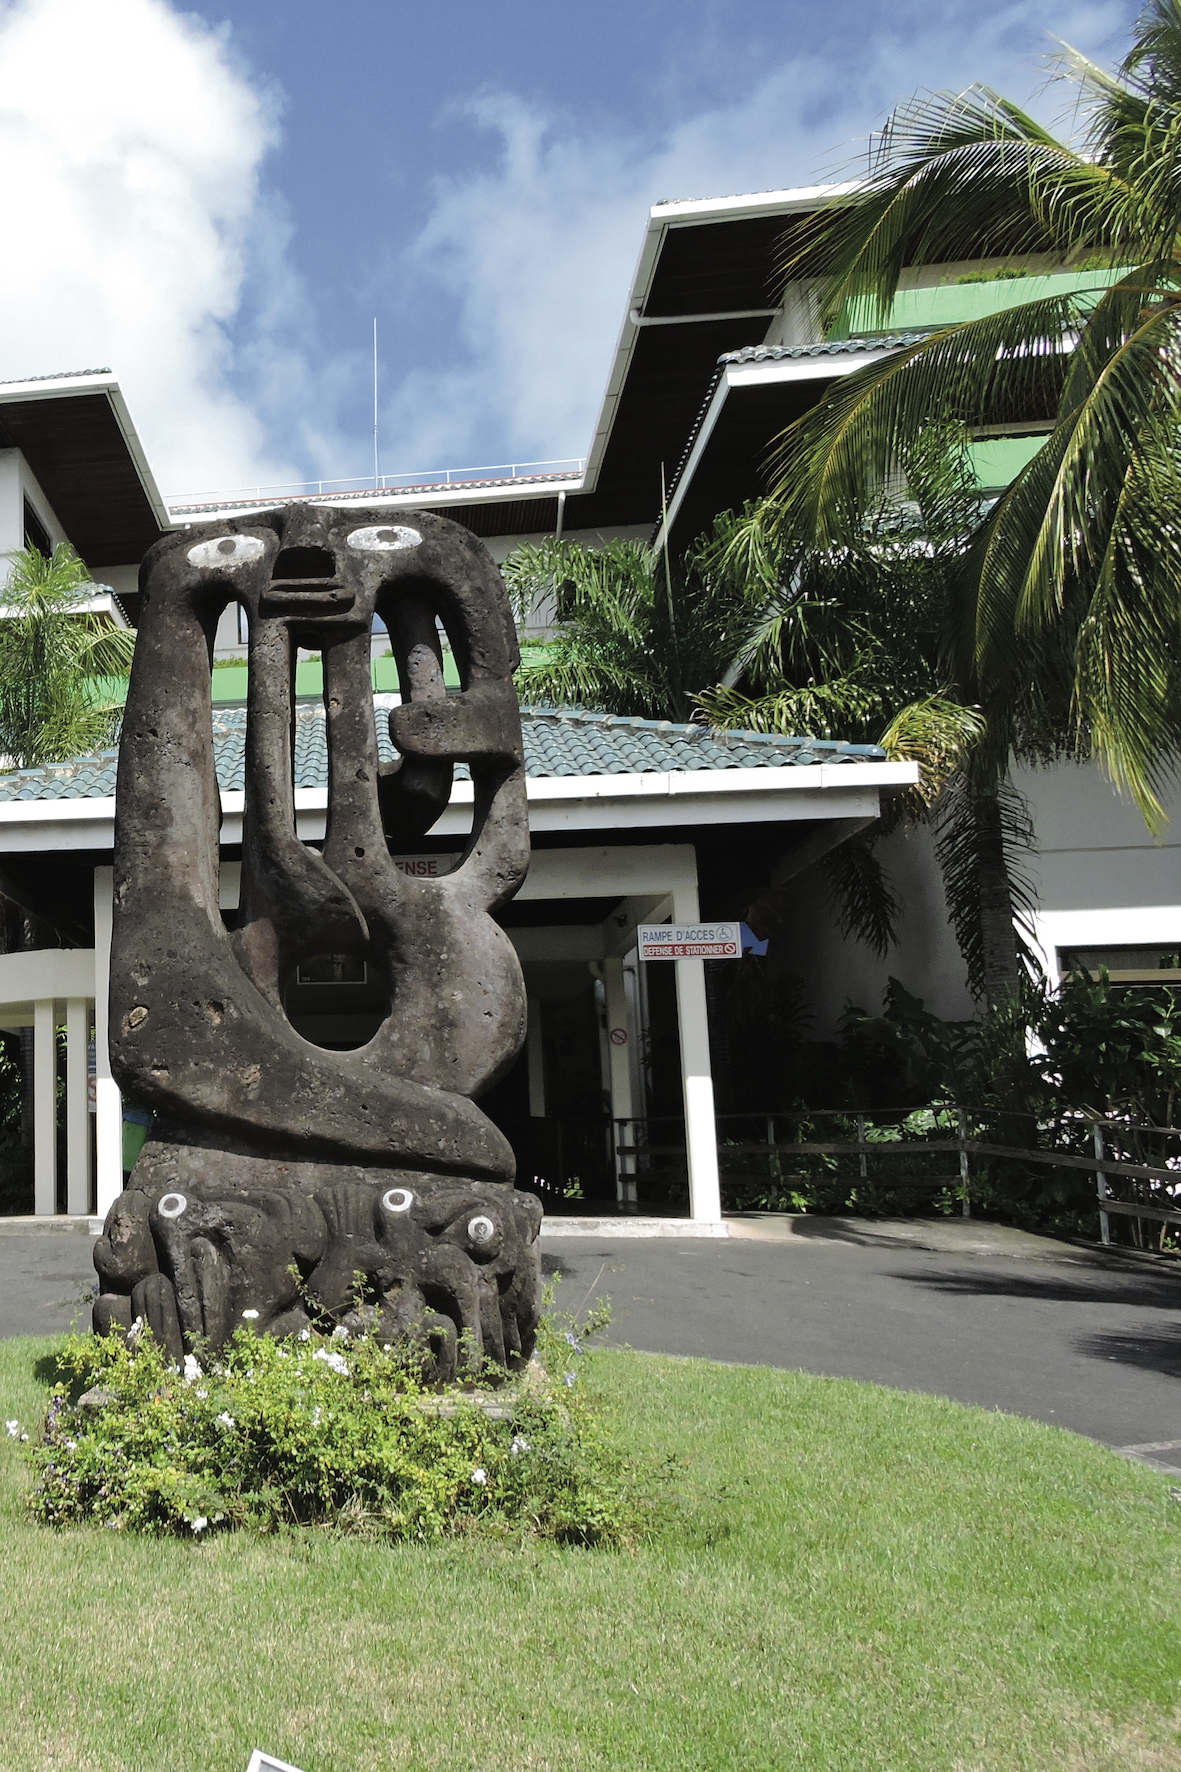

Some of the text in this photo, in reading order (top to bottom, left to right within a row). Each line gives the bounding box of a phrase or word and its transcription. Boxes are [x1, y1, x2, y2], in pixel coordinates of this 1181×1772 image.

[643, 929, 715, 942] RAMPE D'ACCES
[644, 944, 724, 956] DEFENSE DE STATIONNER
